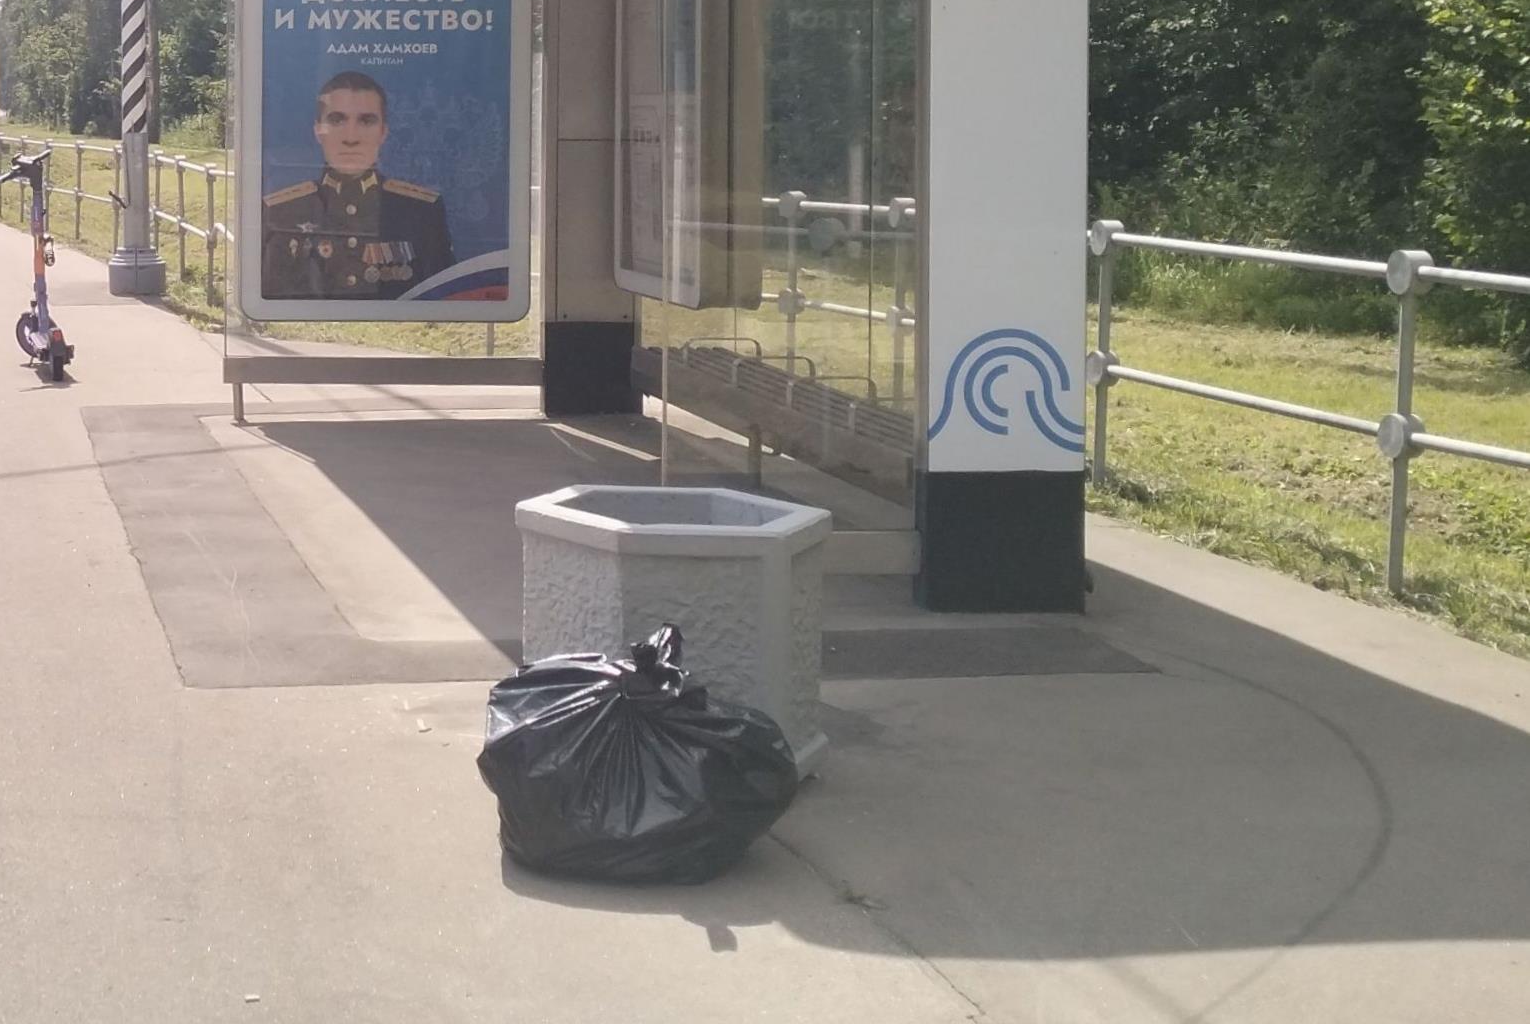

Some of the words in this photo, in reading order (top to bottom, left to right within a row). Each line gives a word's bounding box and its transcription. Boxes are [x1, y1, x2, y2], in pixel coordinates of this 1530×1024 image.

[274, 8, 295, 30] И
[307, 9, 494, 31] МУЖЕСТВО!
[326, 42, 369, 55] АДАМ
[372, 42, 438, 54] ХАМХОЕВ
[360, 57, 404, 65] КАПИТАН
